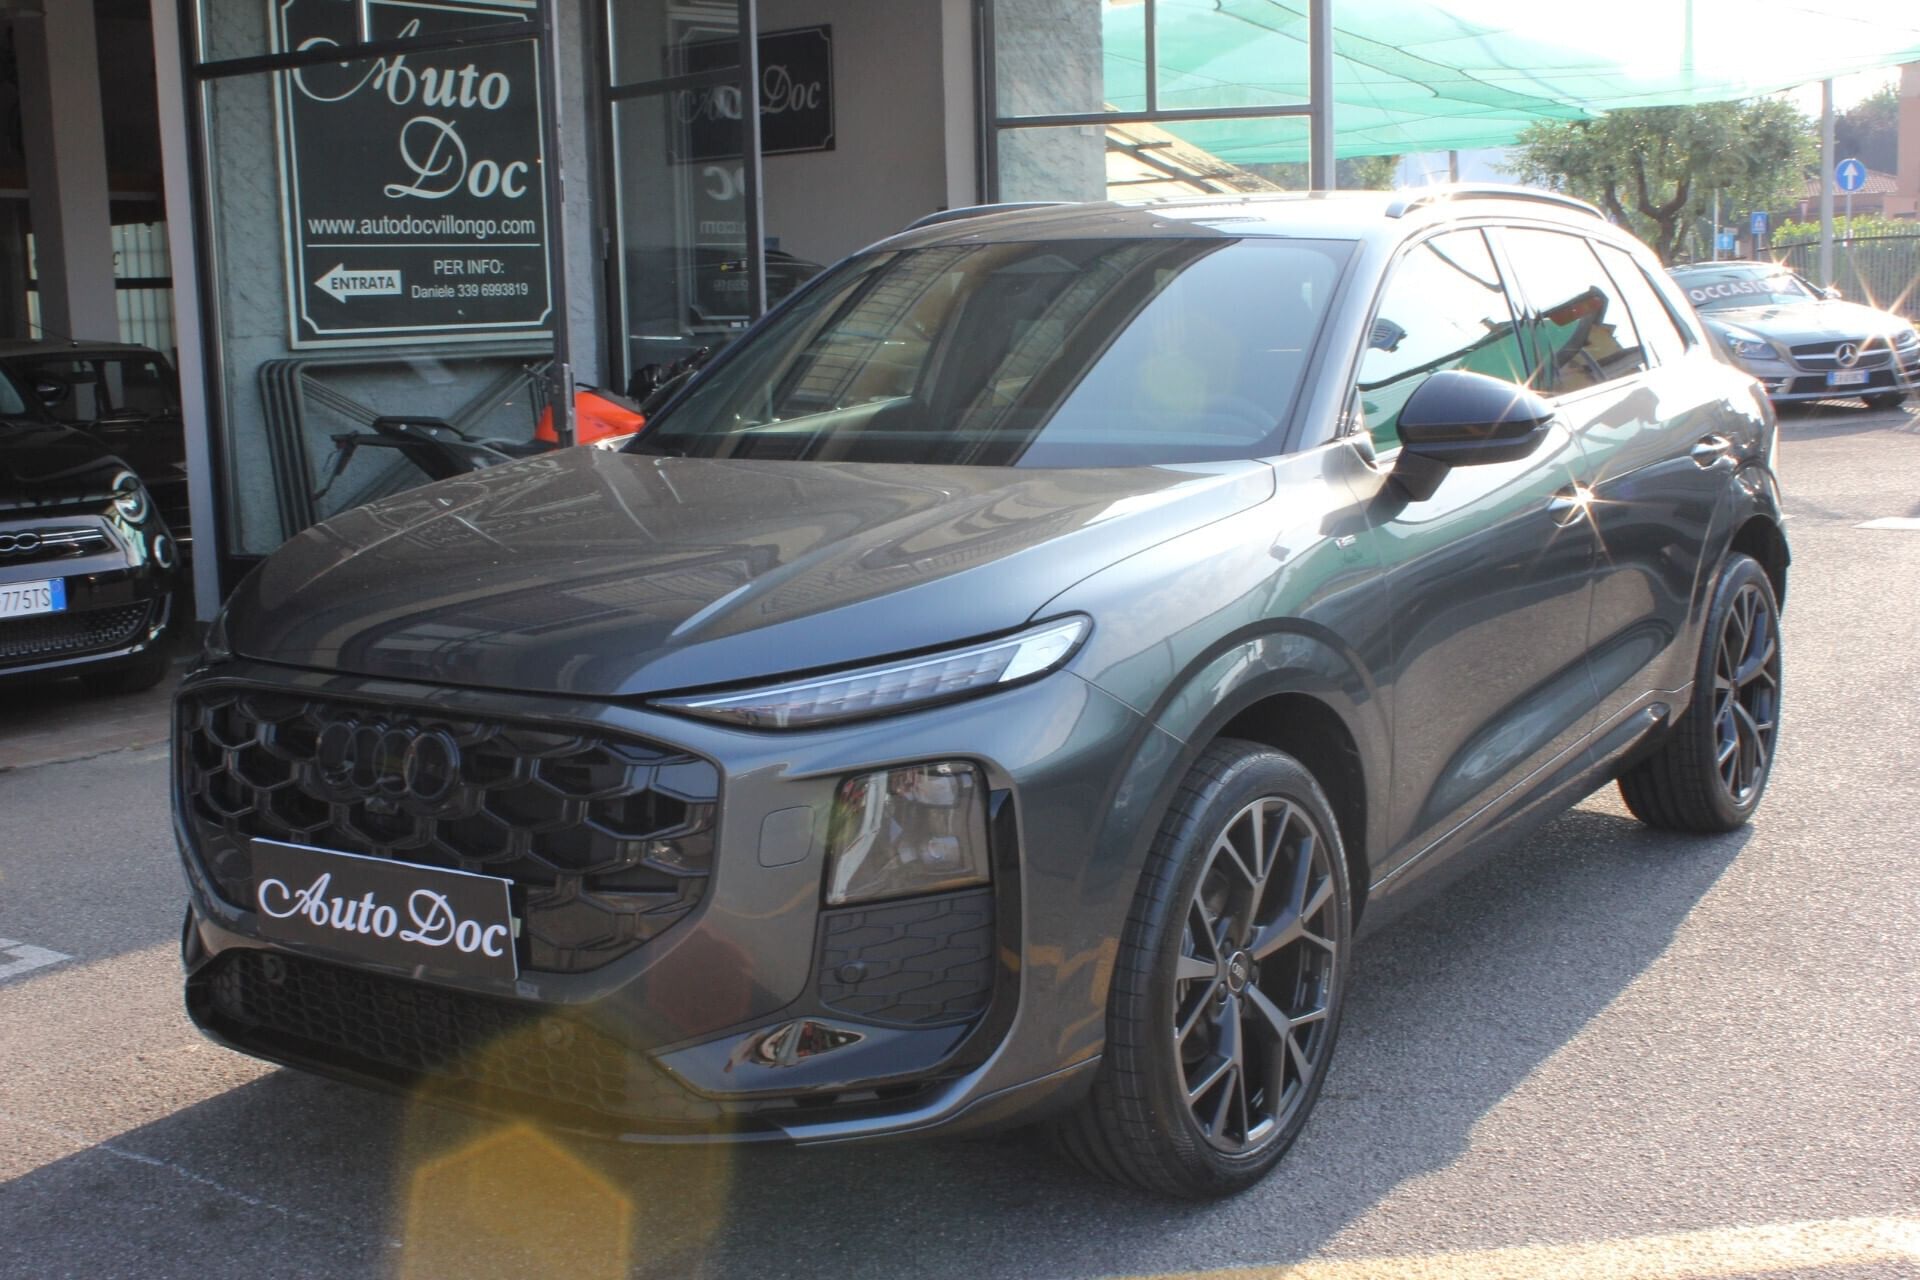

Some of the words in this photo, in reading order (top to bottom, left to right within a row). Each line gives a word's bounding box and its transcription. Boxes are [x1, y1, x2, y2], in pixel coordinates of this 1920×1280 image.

[293, 19, 510, 109] Auto
[759, 65, 821, 113] Doc
[384, 116, 528, 199] Doc
[308, 215, 536, 239] www.autodocvillongo.com
[434, 259, 464, 275] PER
[467, 259, 505, 275] INFO:
[331, 276, 396, 290] ENTRATA
[411, 285, 456, 299] Daniele
[457, 284, 479, 297] 339
[481, 283, 529, 297] 6993819
[1690, 280, 1798, 302] OCCASIOE
[0, 587, 51, 612] 775TS
[258, 873, 398, 938] Auto
[400, 889, 508, 958] Doc
